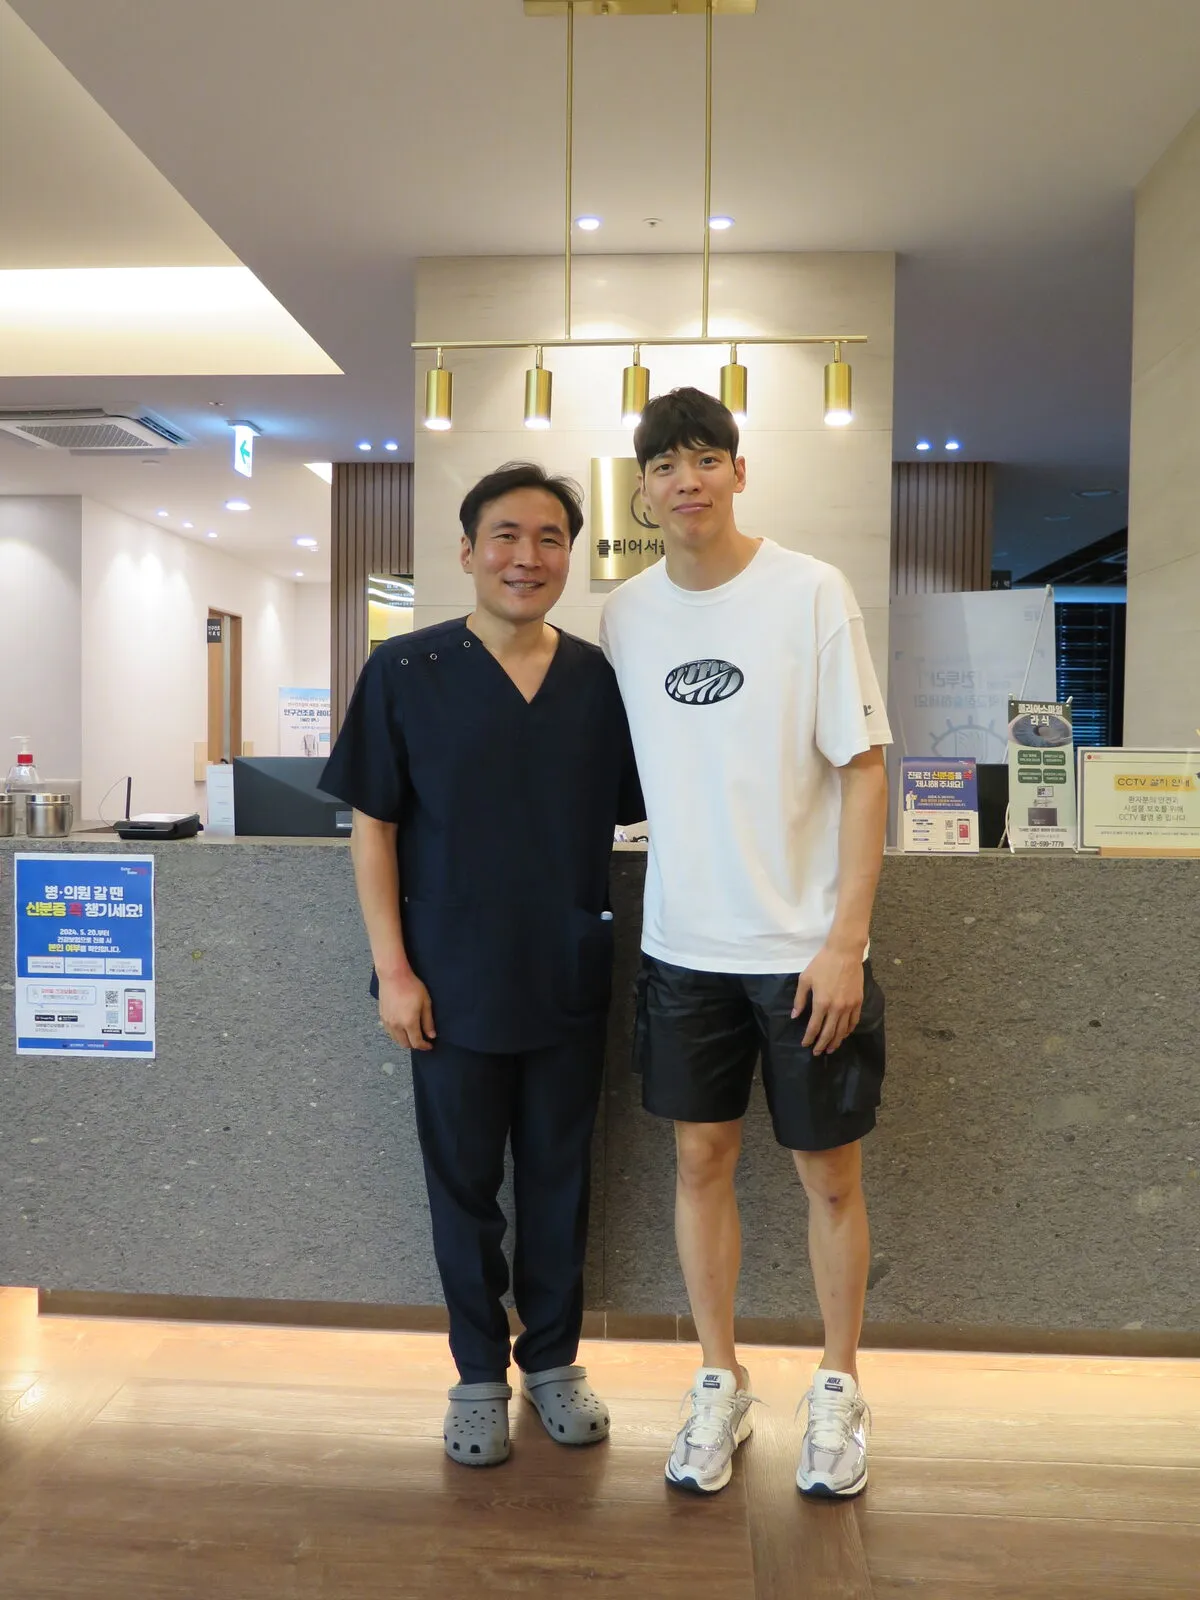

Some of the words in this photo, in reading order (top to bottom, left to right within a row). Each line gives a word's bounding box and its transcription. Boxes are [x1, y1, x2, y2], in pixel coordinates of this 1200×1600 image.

[1117, 778, 1146, 786] CCTV
[93, 886, 108, 901] 갈
[109, 886, 124, 901] 땐
[26, 901, 66, 917] 신분증
[84, 903, 143, 918] 챙기세요!
